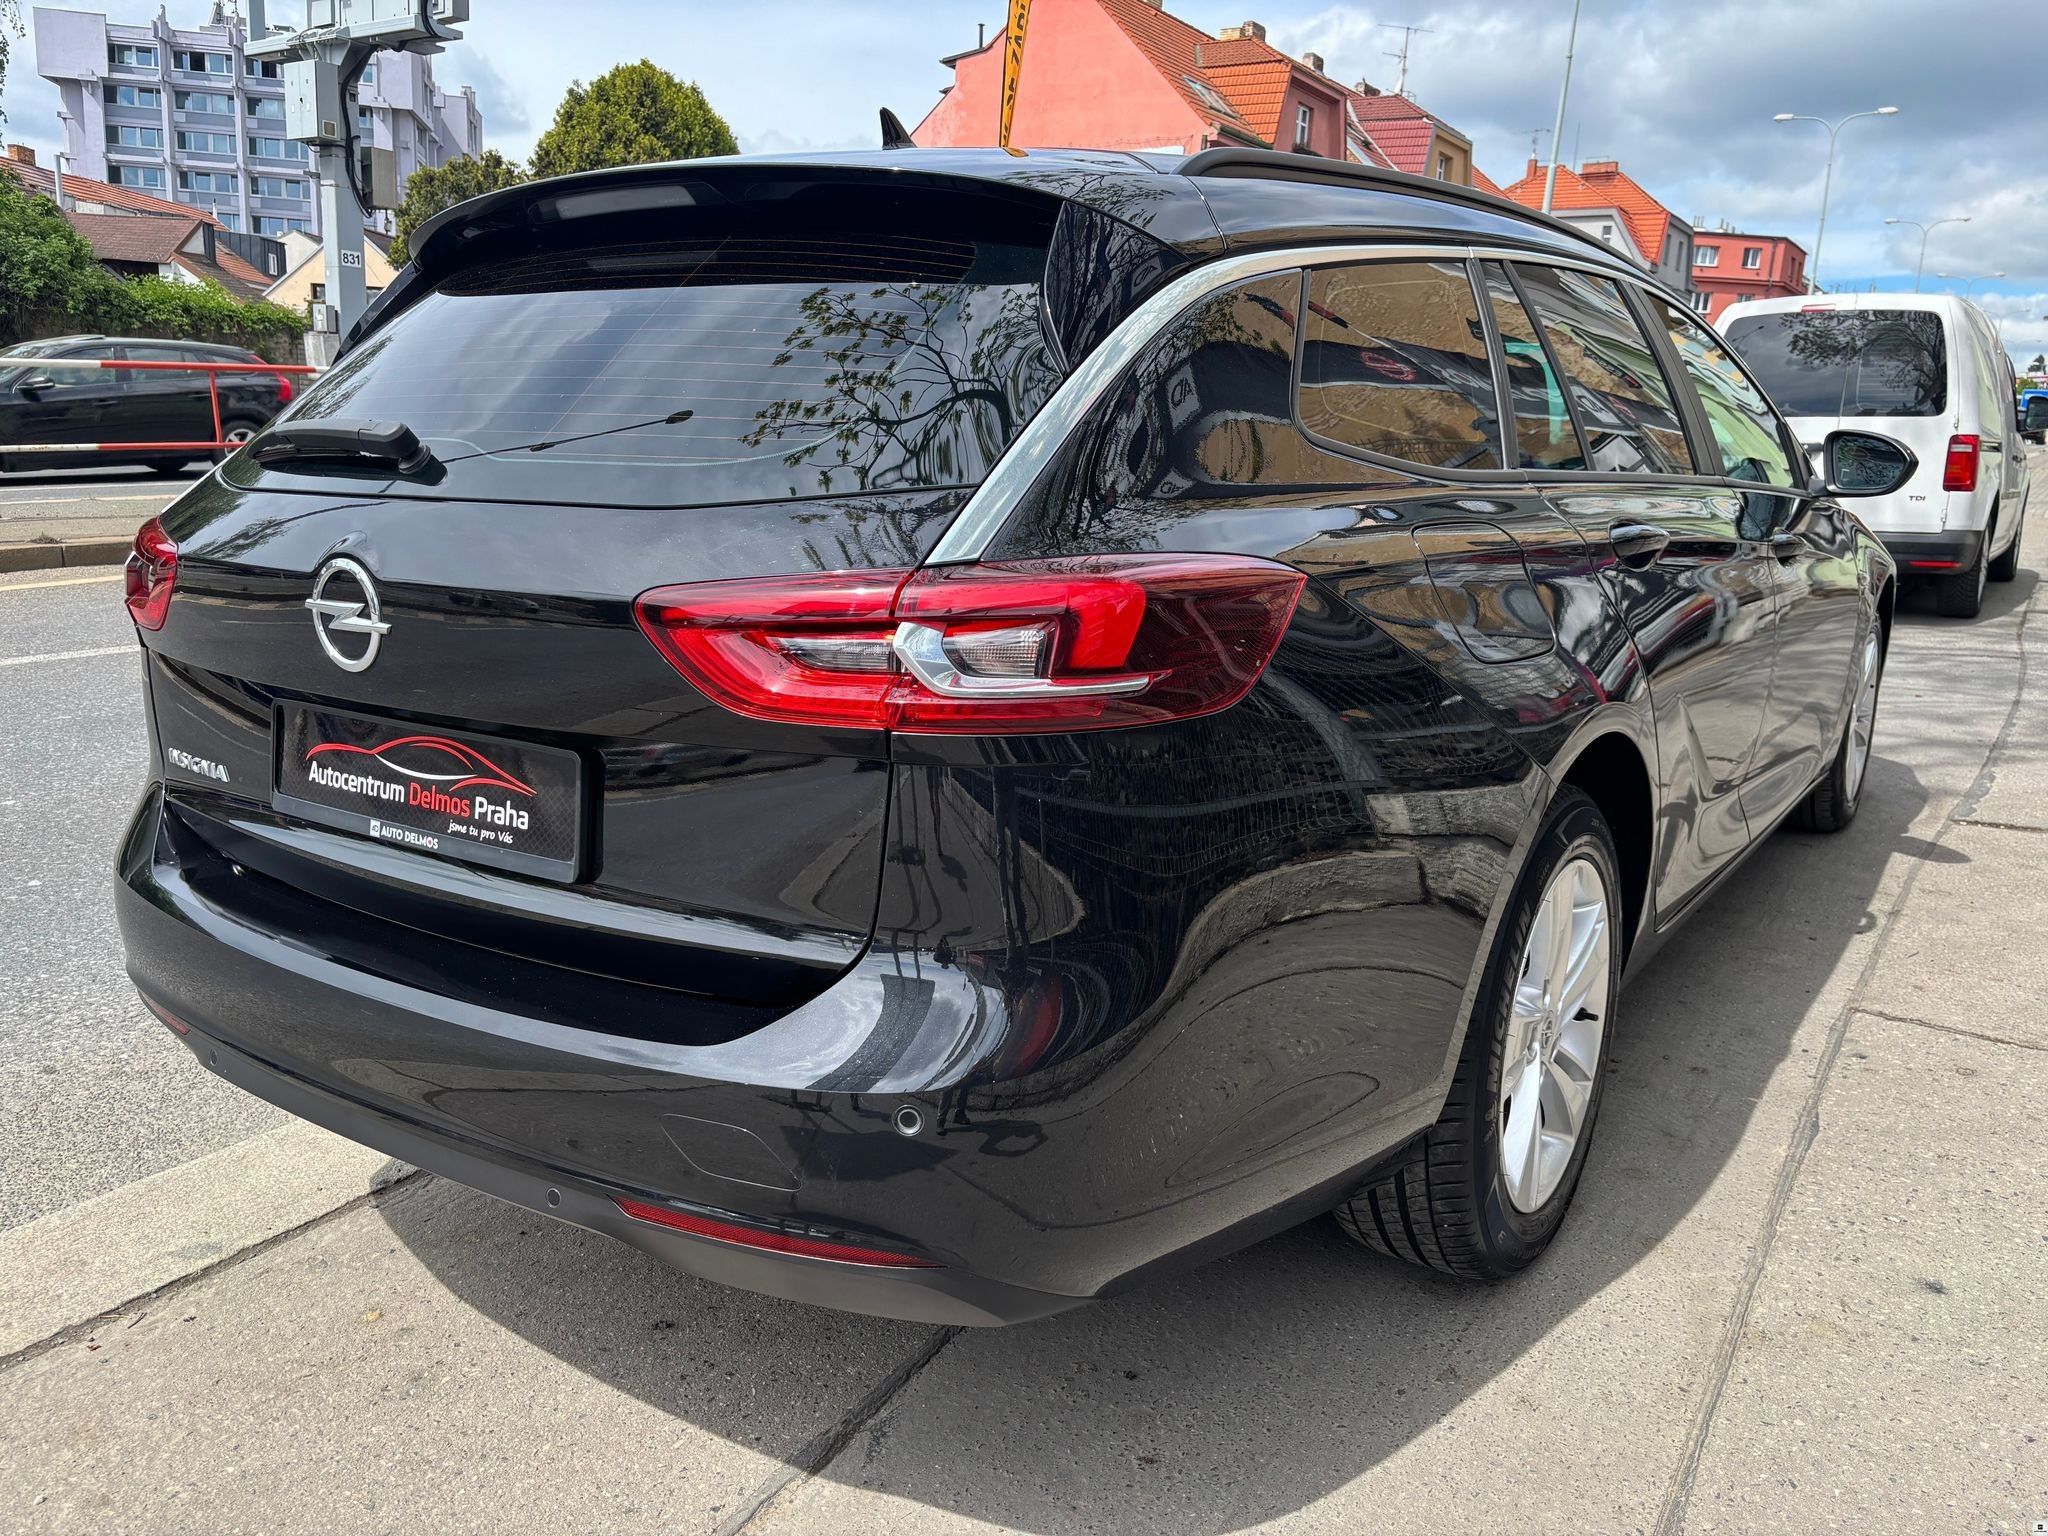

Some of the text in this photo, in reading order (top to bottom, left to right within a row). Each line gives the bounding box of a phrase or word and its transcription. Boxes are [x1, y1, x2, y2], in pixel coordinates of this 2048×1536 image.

[343, 253, 360, 265] 831
[168, 747, 230, 782] INSIGNIA
[309, 761, 529, 830] Autocentrum Delmos Praha
[381, 826, 438, 849] AUTO DELMOS
[447, 819, 513, 843] jsme tu pro Vás
[1486, 901, 1532, 1093] MICHELIN
